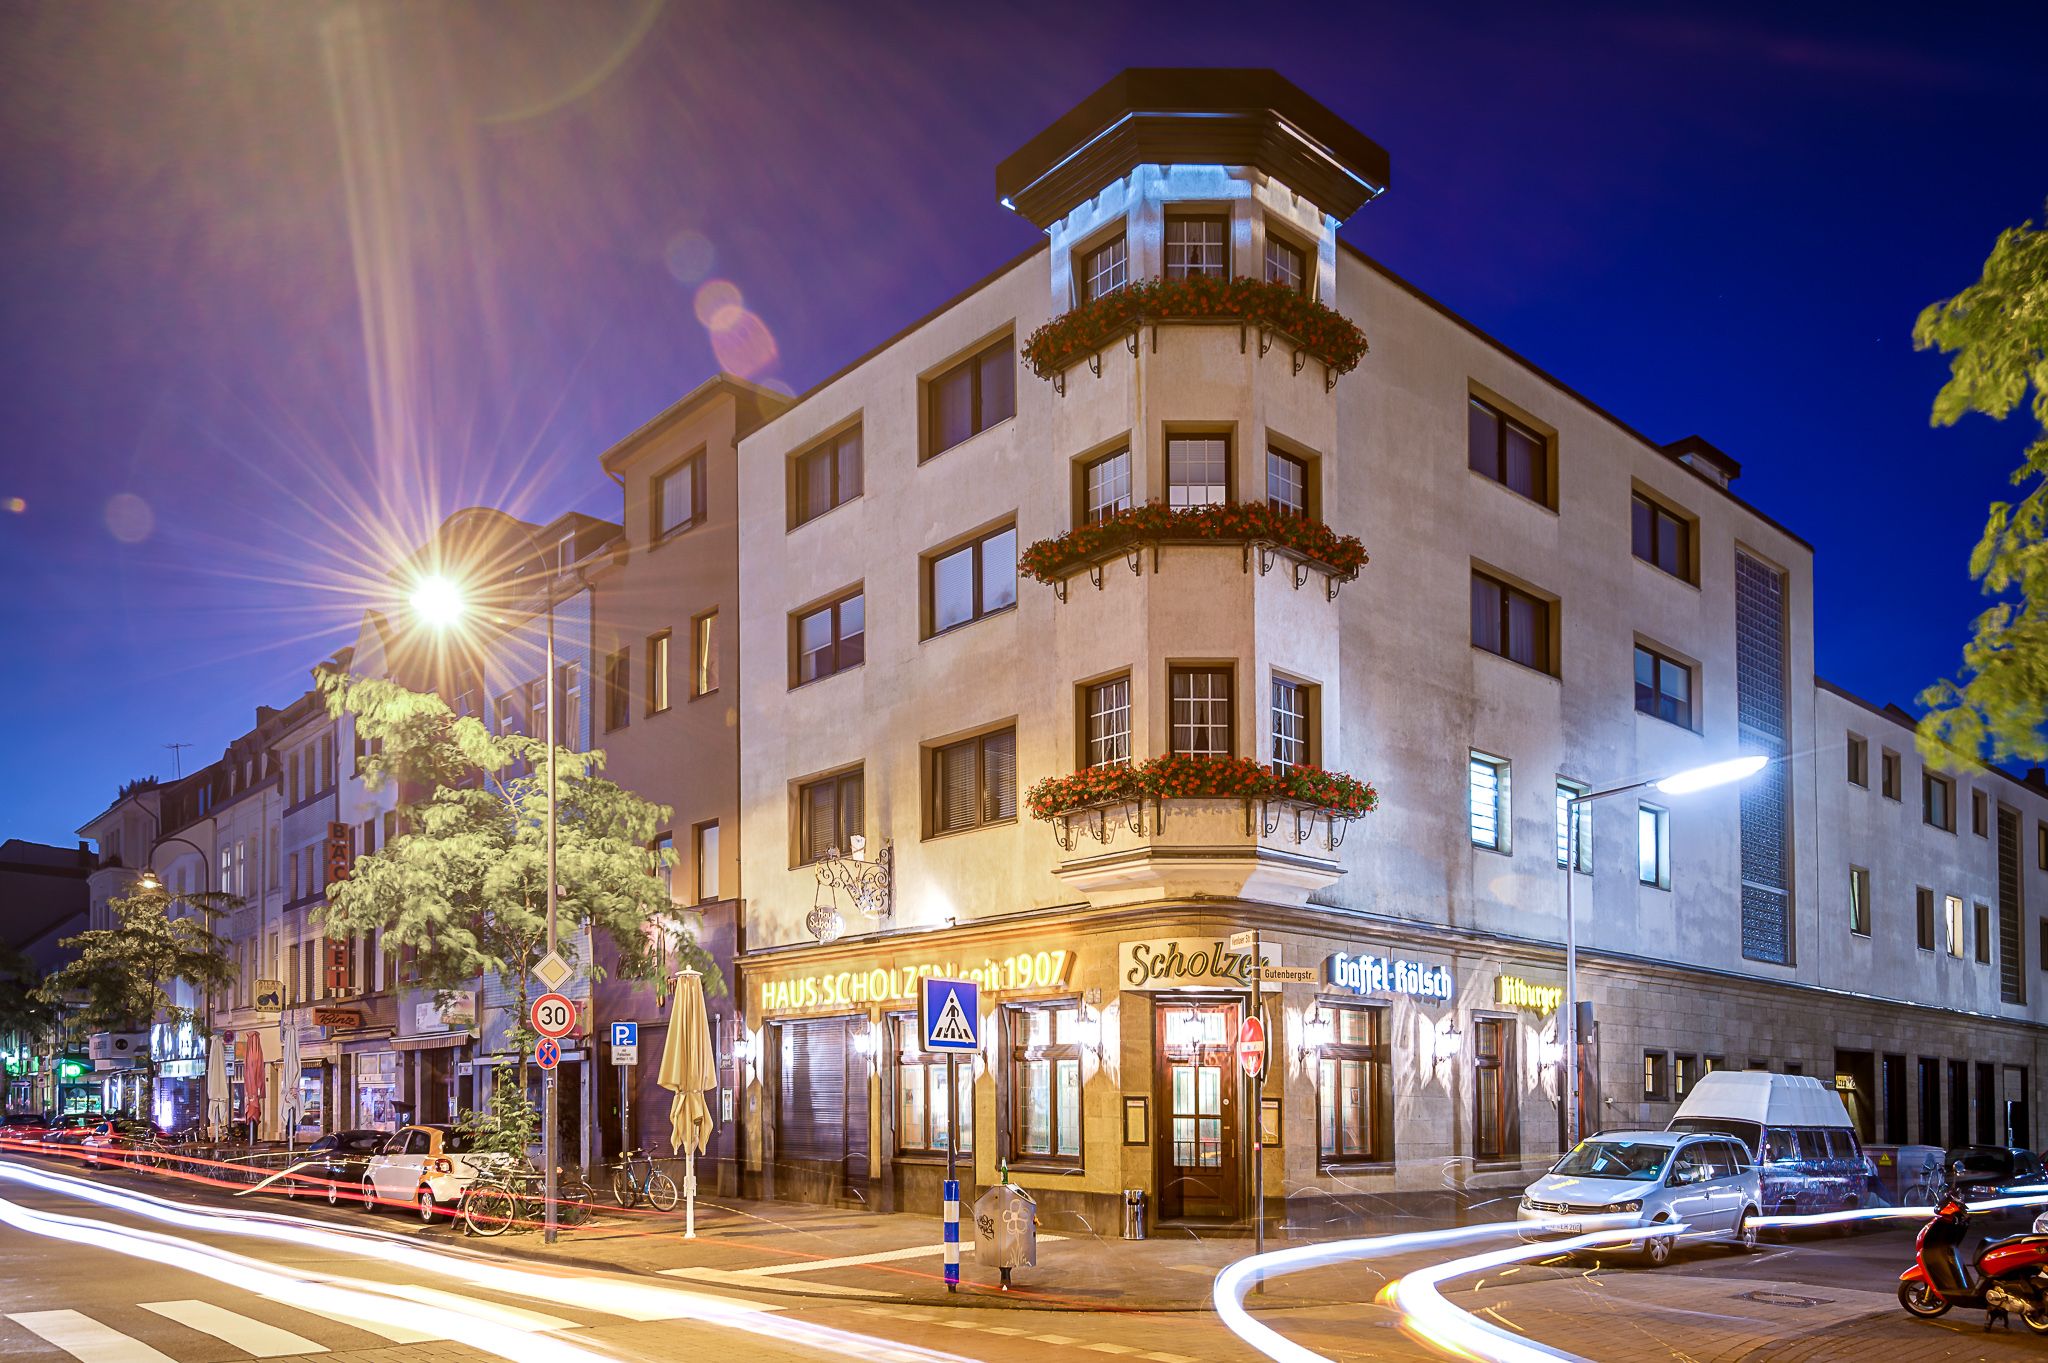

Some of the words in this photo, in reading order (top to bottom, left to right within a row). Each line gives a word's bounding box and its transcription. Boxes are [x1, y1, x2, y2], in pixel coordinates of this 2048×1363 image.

[332, 822, 346, 987] BÄCEI
[818, 908, 836, 919] Hau
[762, 975, 816, 1009] HAUS
[1003, 949, 1067, 988] 1907
[1264, 968, 1315, 982] Gutenbergstr.
[1335, 951, 1452, 1001] Gaffel-Kölsch
[1501, 975, 1563, 1015] Bitburger
[541, 1006, 566, 1026] 30
[615, 1025, 630, 1046] P
[402, 1113, 409, 1121] P
